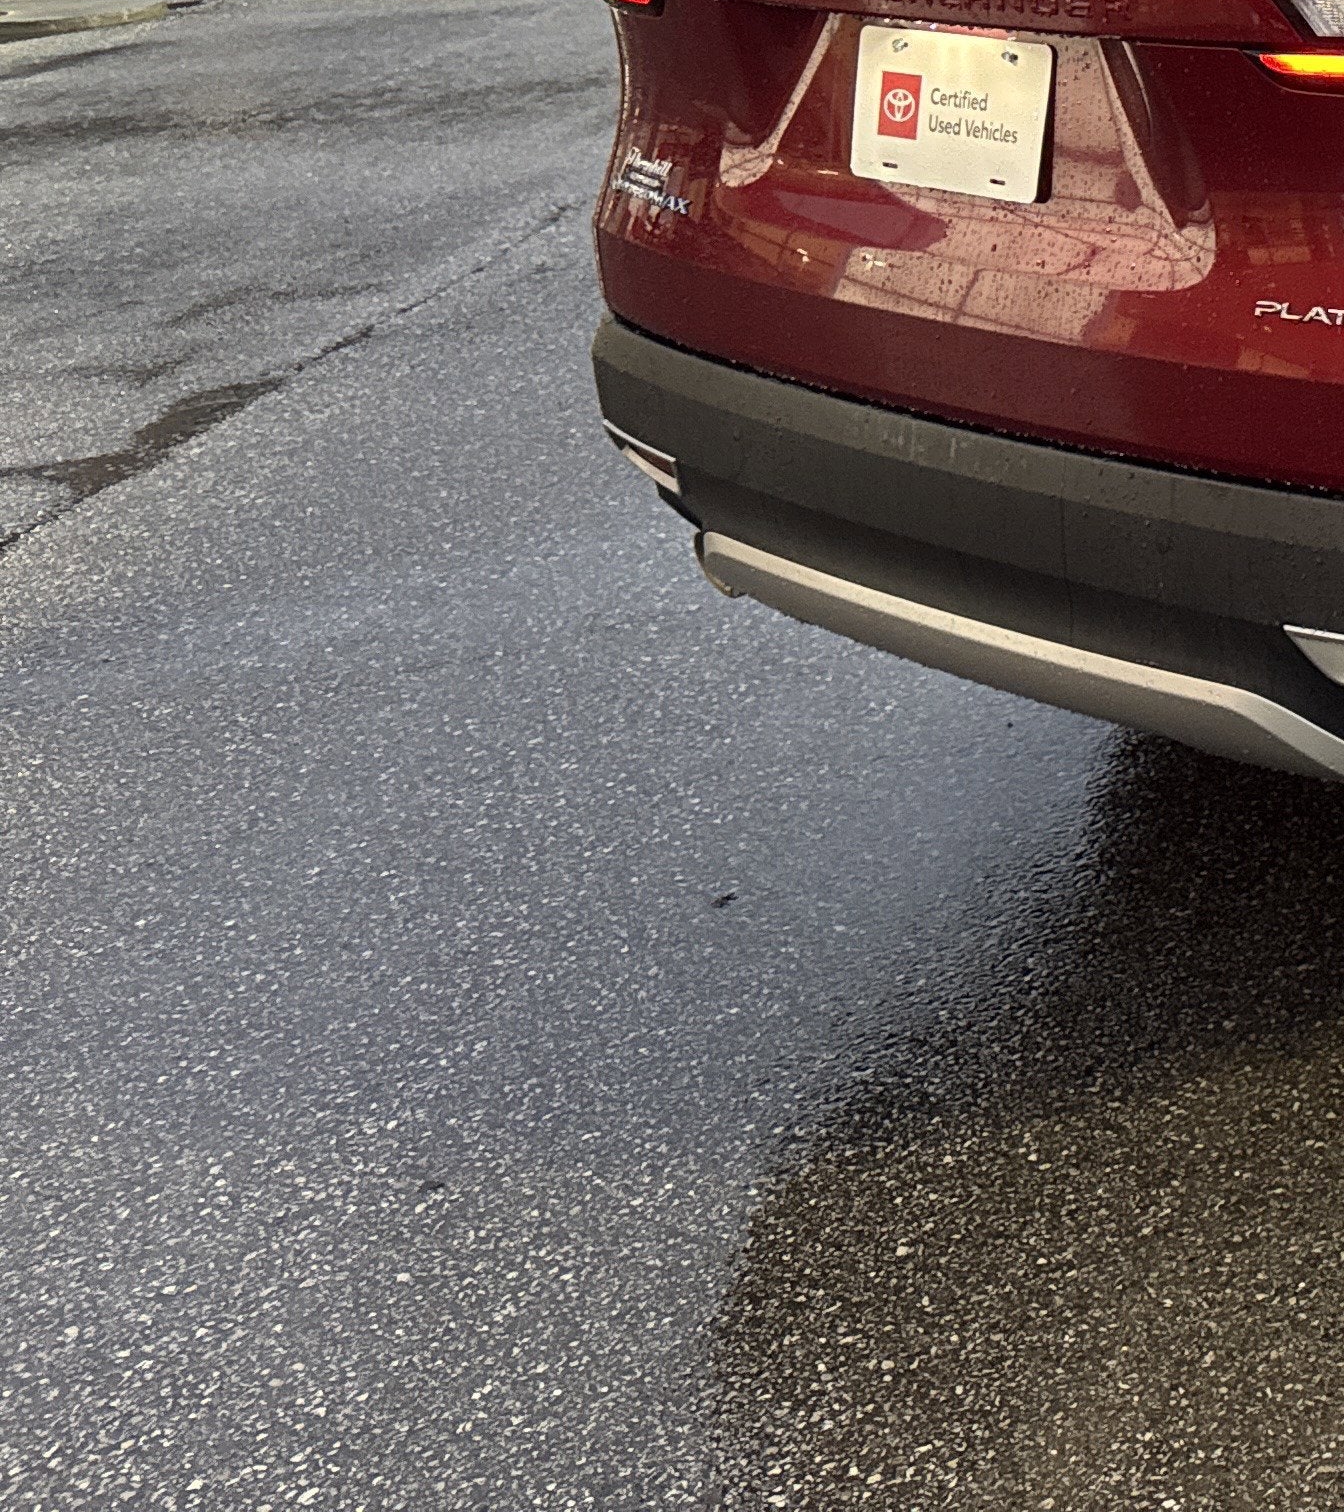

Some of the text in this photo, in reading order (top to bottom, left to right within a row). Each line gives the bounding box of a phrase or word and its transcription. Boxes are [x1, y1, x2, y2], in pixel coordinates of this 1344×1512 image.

[930, 87, 988, 111] Certified
[928, 114, 1018, 144] Used Vehicles
